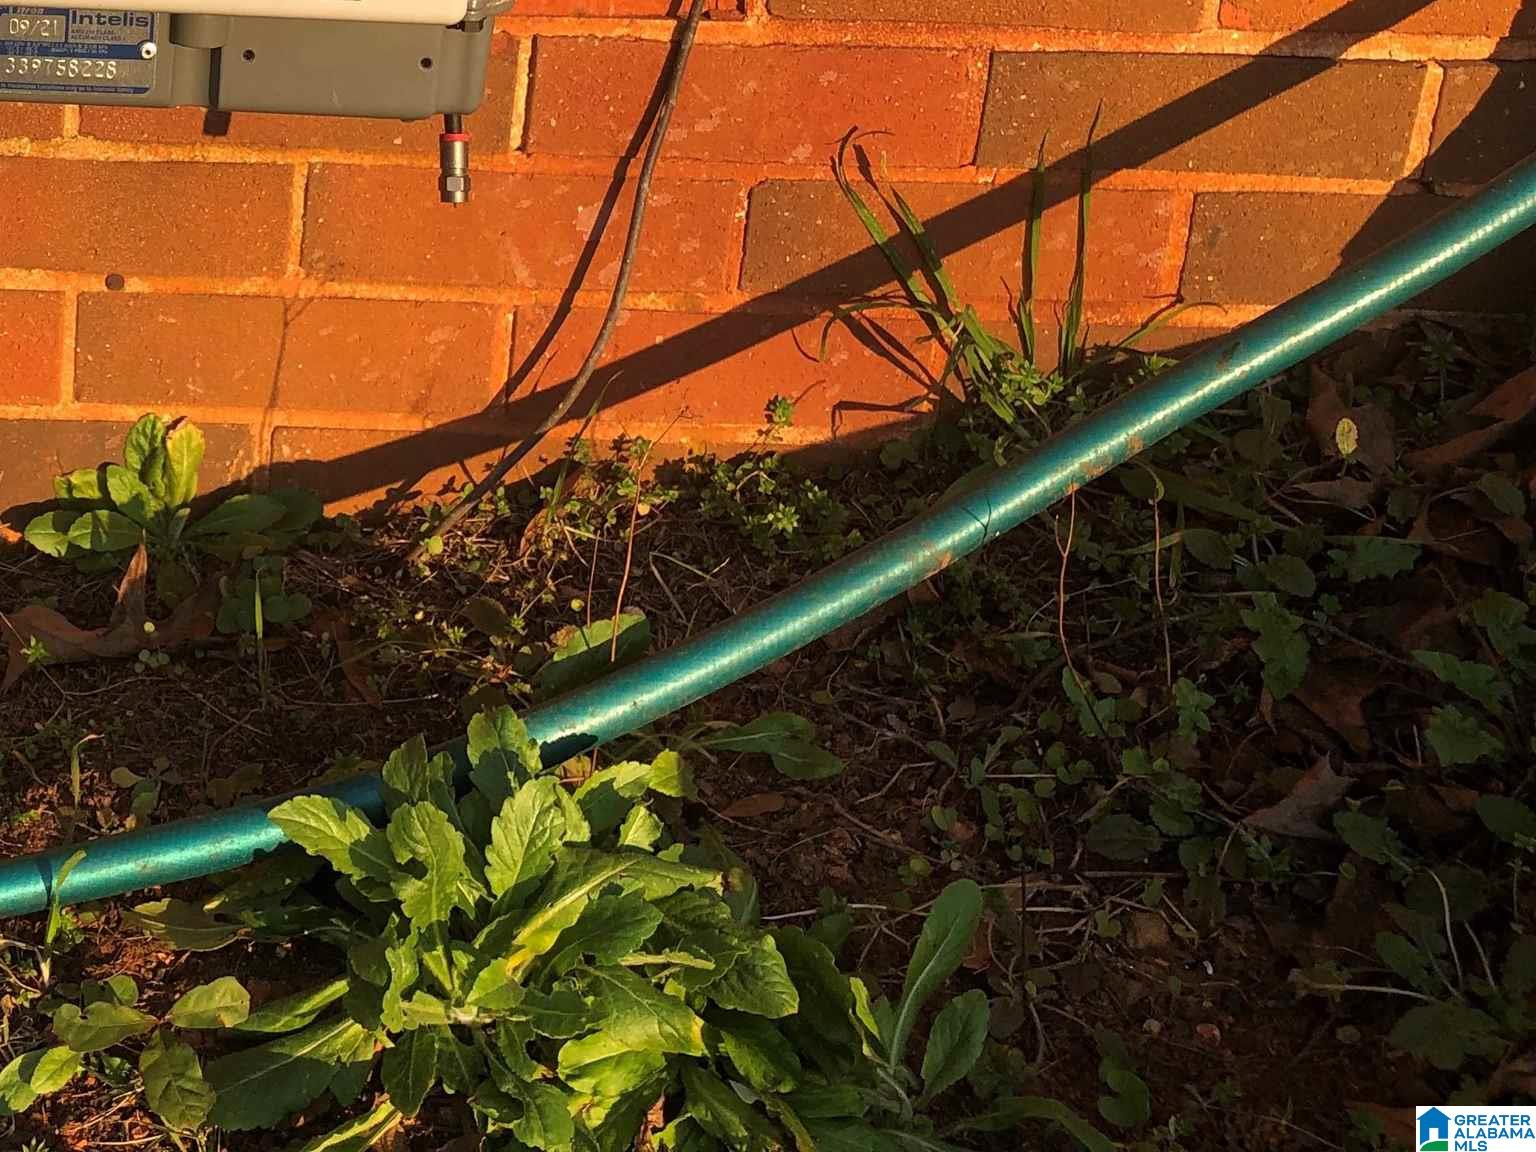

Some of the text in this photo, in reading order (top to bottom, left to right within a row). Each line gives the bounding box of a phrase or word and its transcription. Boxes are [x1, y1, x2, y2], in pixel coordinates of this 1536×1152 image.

[9, 18, 58, 36] 09/21
[71, 10, 150, 27] Intelis
[5, 57, 117, 80] 339758228
